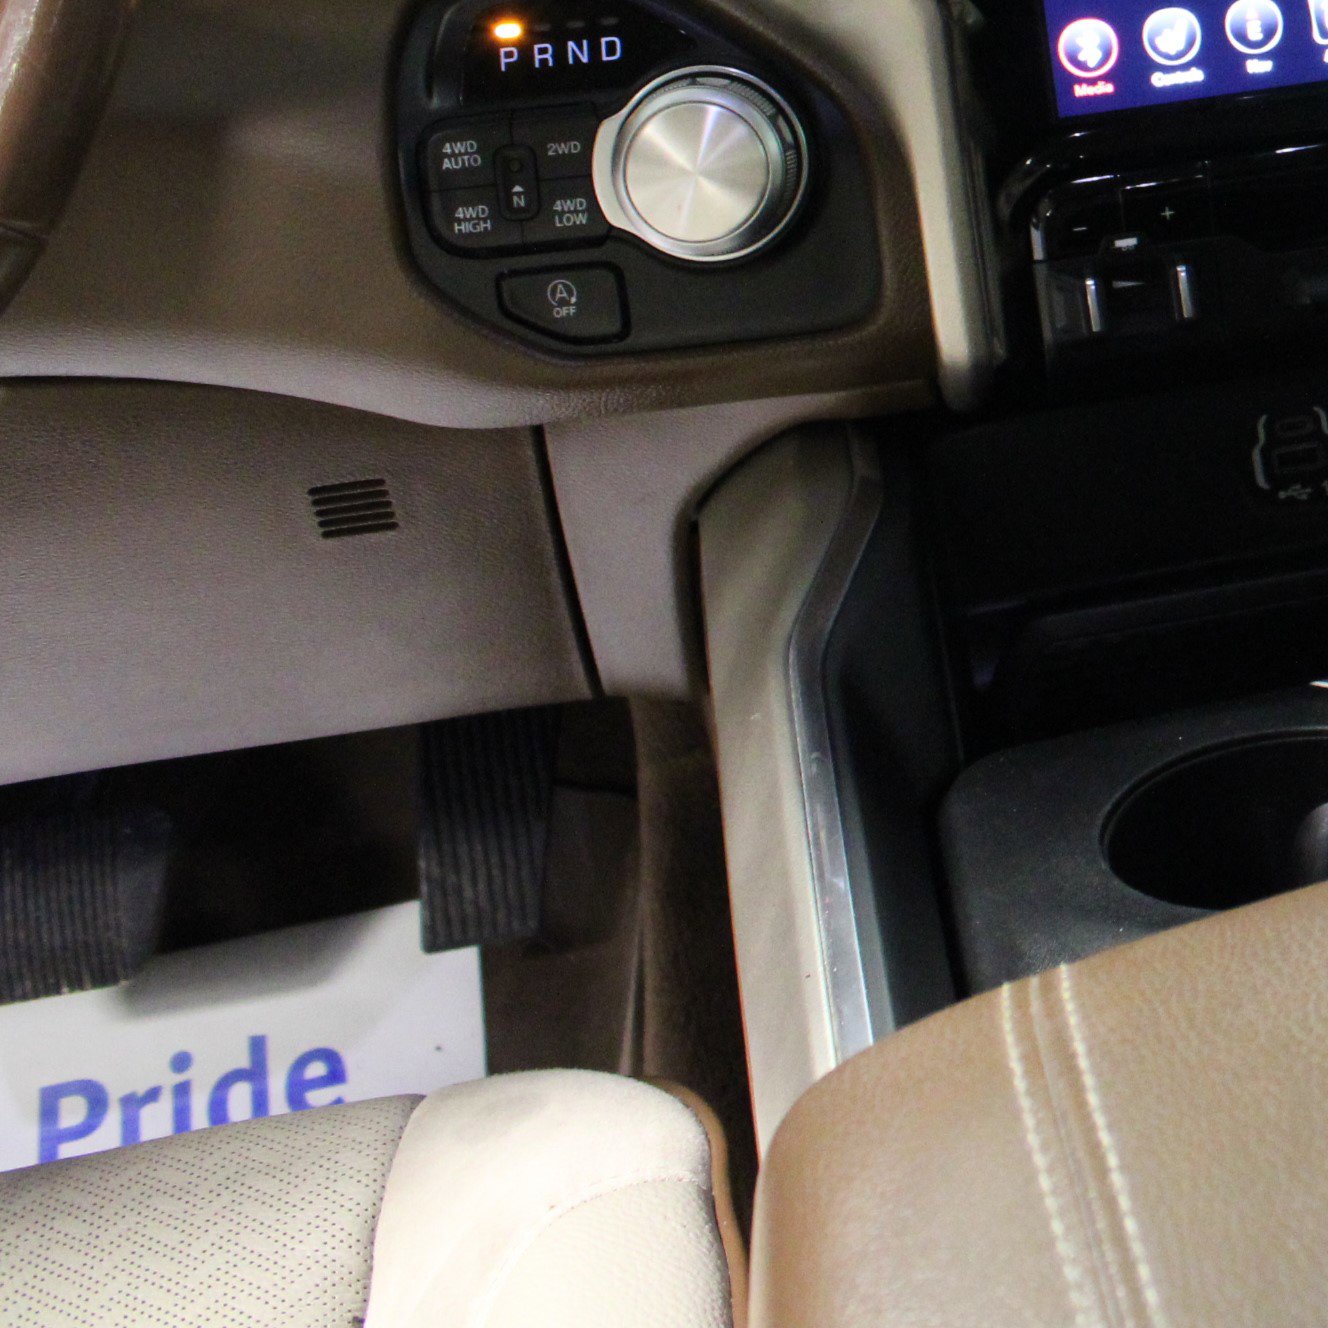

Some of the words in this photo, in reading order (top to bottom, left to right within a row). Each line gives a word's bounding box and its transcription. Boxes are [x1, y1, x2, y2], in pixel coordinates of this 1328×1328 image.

[1073, 80, 1115, 98] Media
[441, 140, 478, 155] 4WD
[546, 140, 581, 156] 2WD
[441, 154, 482, 171] AUTO
[454, 205, 489, 219] 4WD
[552, 198, 587, 213] 4WD
[454, 219, 491, 235] HIGH
[555, 211, 588, 228] LOW
[553, 305, 576, 319] OFF
[38, 1034, 348, 1164] Pride
